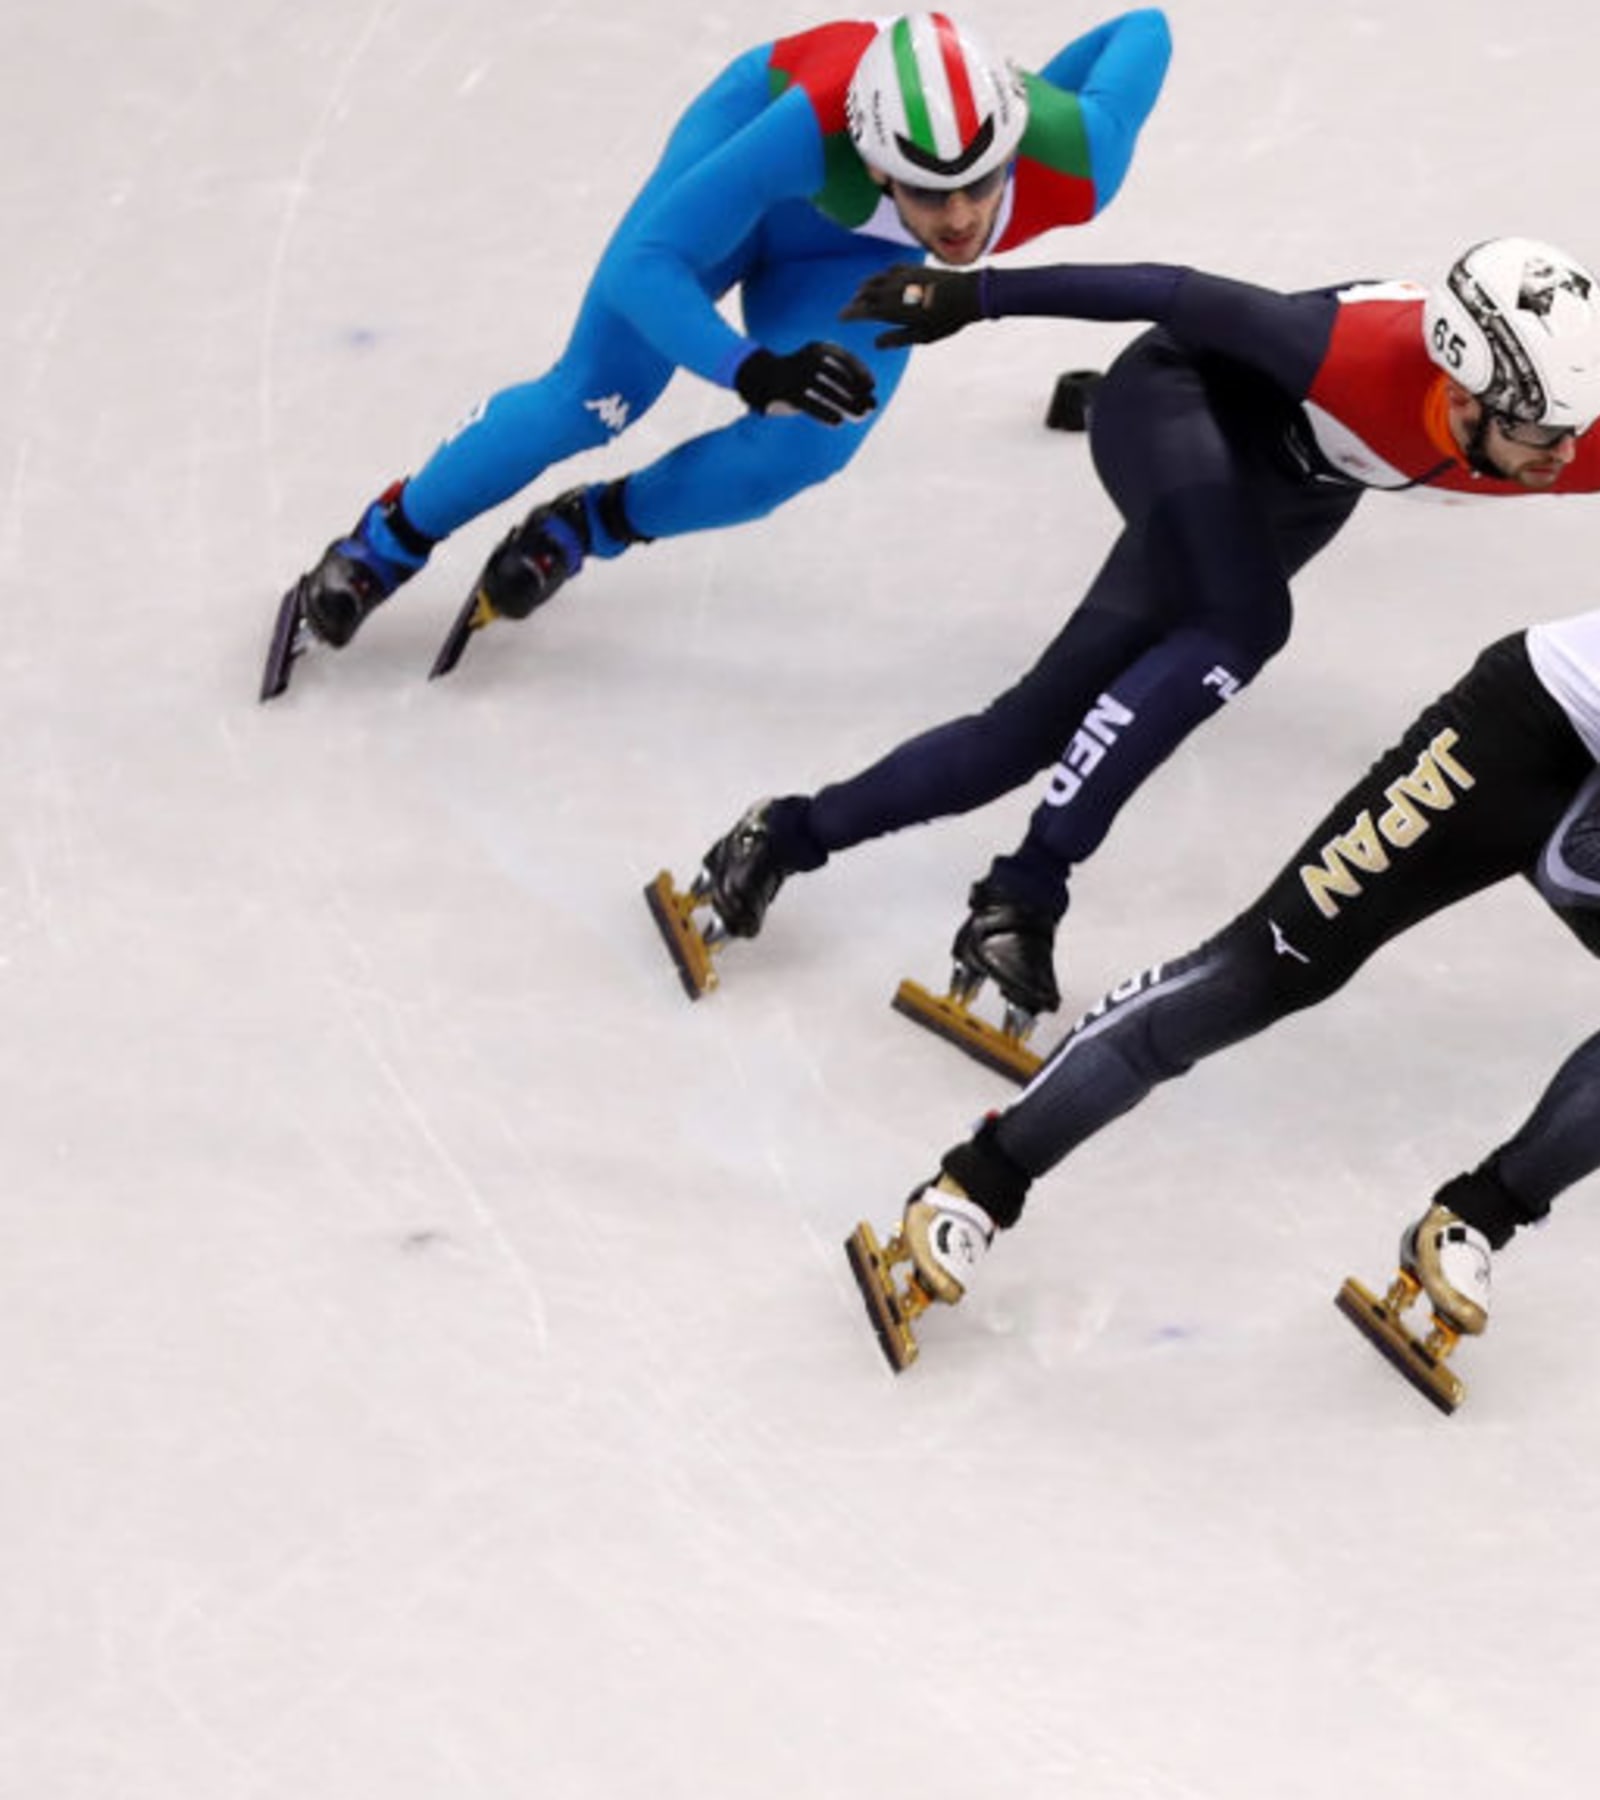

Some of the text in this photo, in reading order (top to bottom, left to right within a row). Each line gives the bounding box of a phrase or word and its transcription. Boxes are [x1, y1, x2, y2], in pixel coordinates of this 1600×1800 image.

[1434, 318, 1467, 369] 65
[1043, 693, 1135, 807] NED
[1299, 727, 1476, 920] JAPAN
